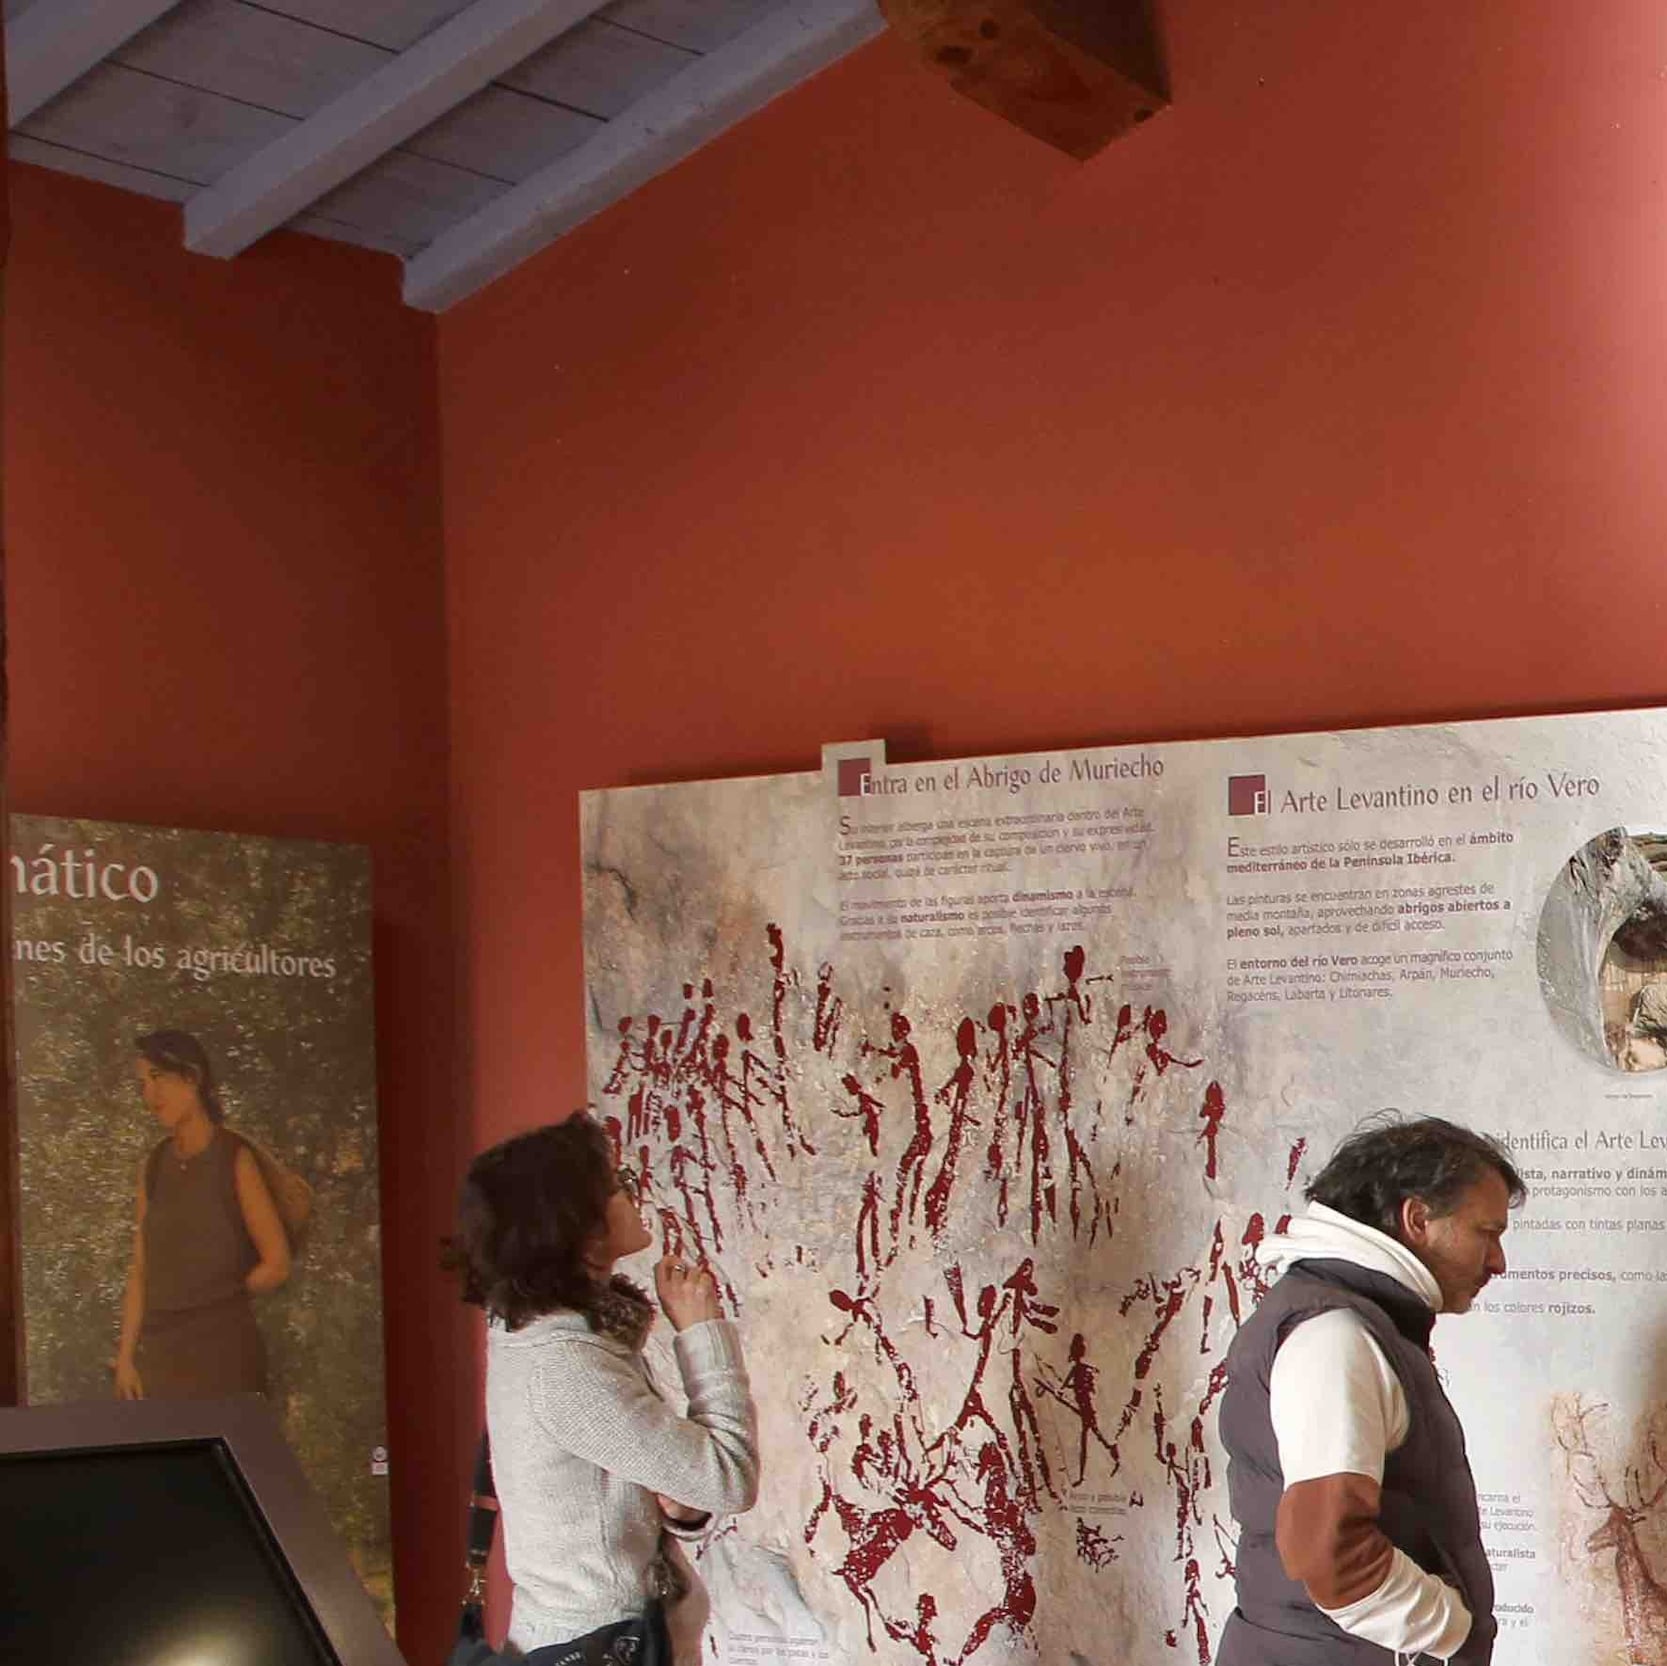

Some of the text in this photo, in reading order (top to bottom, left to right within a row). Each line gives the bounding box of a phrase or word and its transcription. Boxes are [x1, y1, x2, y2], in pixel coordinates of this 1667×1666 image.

[860, 752, 1165, 798] Entra en el Abrigo de Muriecho
[1254, 773, 1600, 815] El Arte Levantino en el río Vero
[78, 932, 115, 966] de
[124, 934, 166, 969] los
[177, 943, 337, 982] agricultores
[1574, 1128, 1588, 1150] el
[1596, 1130, 1632, 1149] Arte
